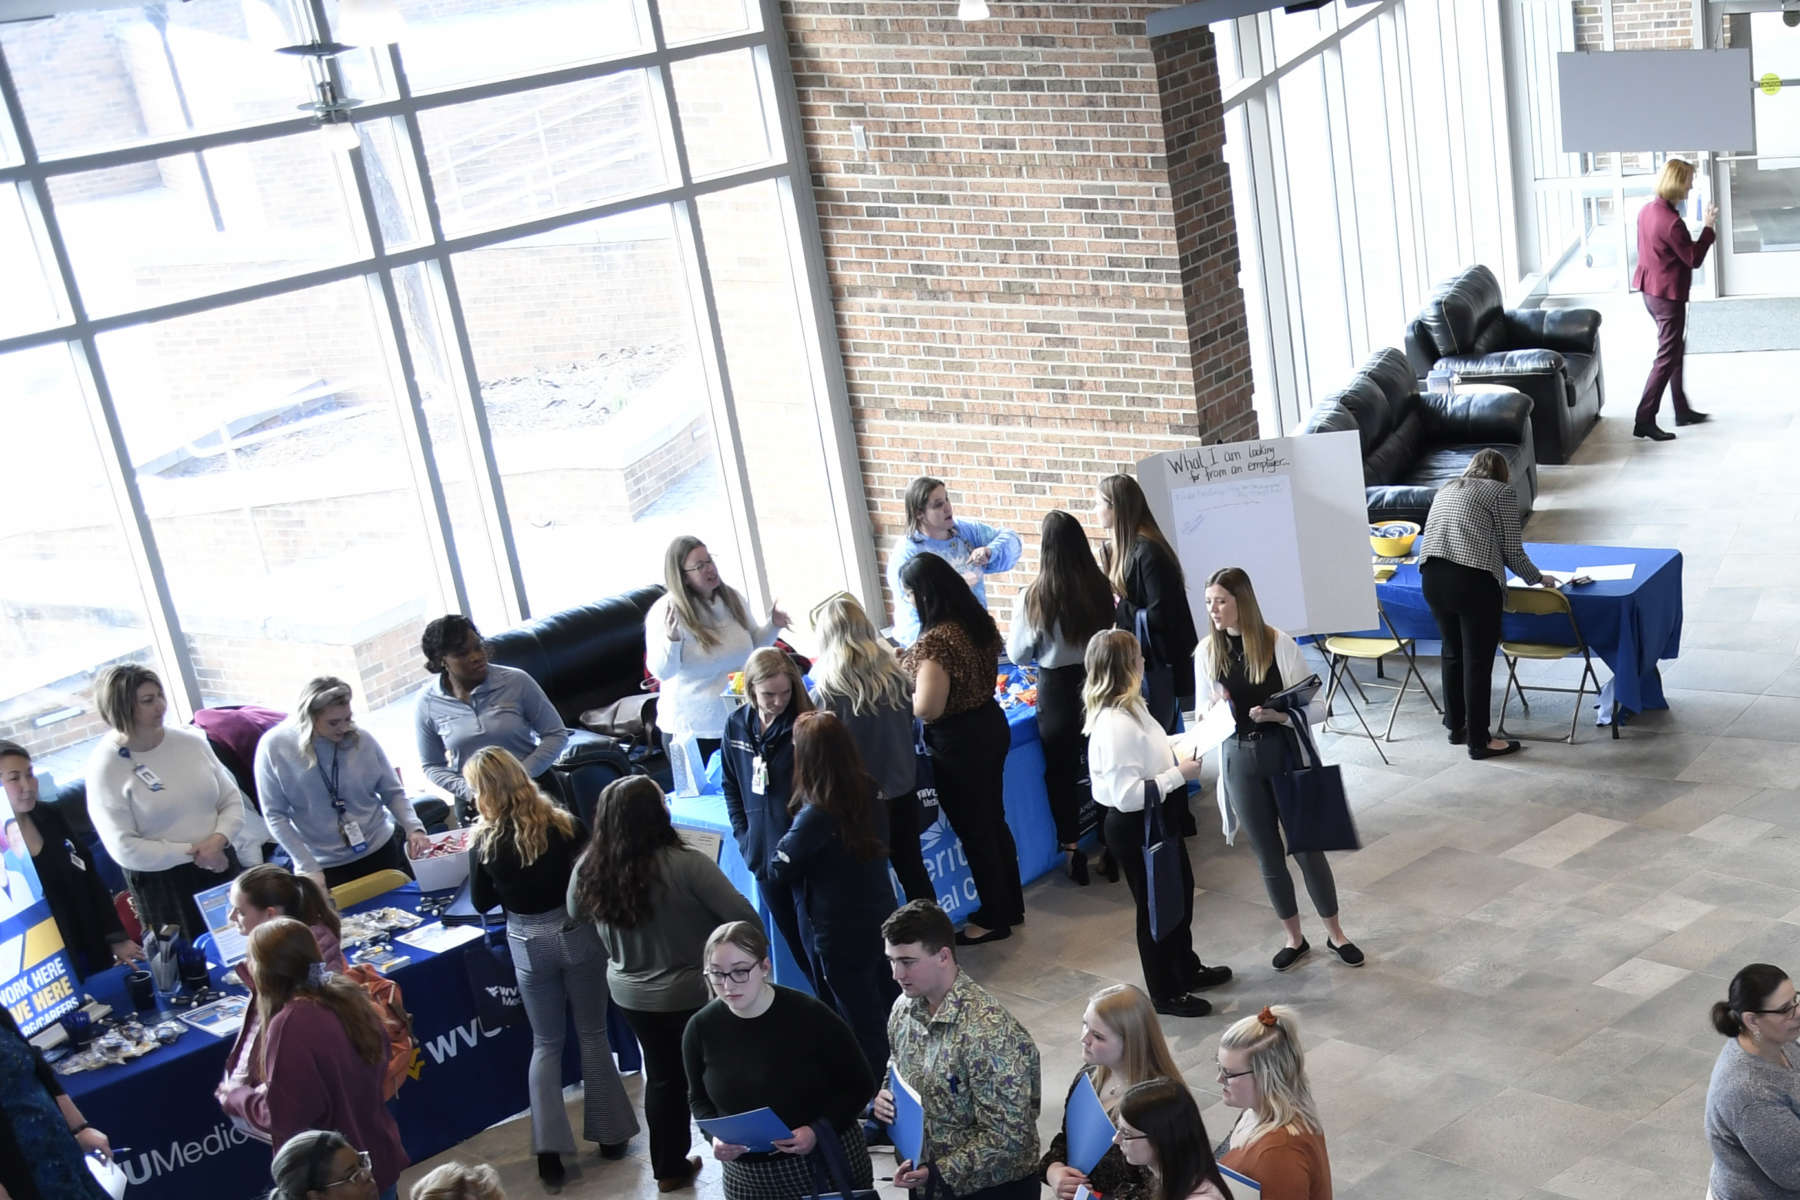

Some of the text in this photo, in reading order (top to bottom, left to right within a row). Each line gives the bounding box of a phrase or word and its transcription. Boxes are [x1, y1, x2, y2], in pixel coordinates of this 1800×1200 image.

[1166, 444, 1276, 475] What I am looking
[1205, 465, 1227, 482] from
[1230, 465, 1243, 475] an
[30, 956, 66, 989] HERE
[8, 975, 75, 1024] VE HERE
[21, 996, 80, 1038] RG/CAREERS
[120, 1122, 251, 1186] UMedic
